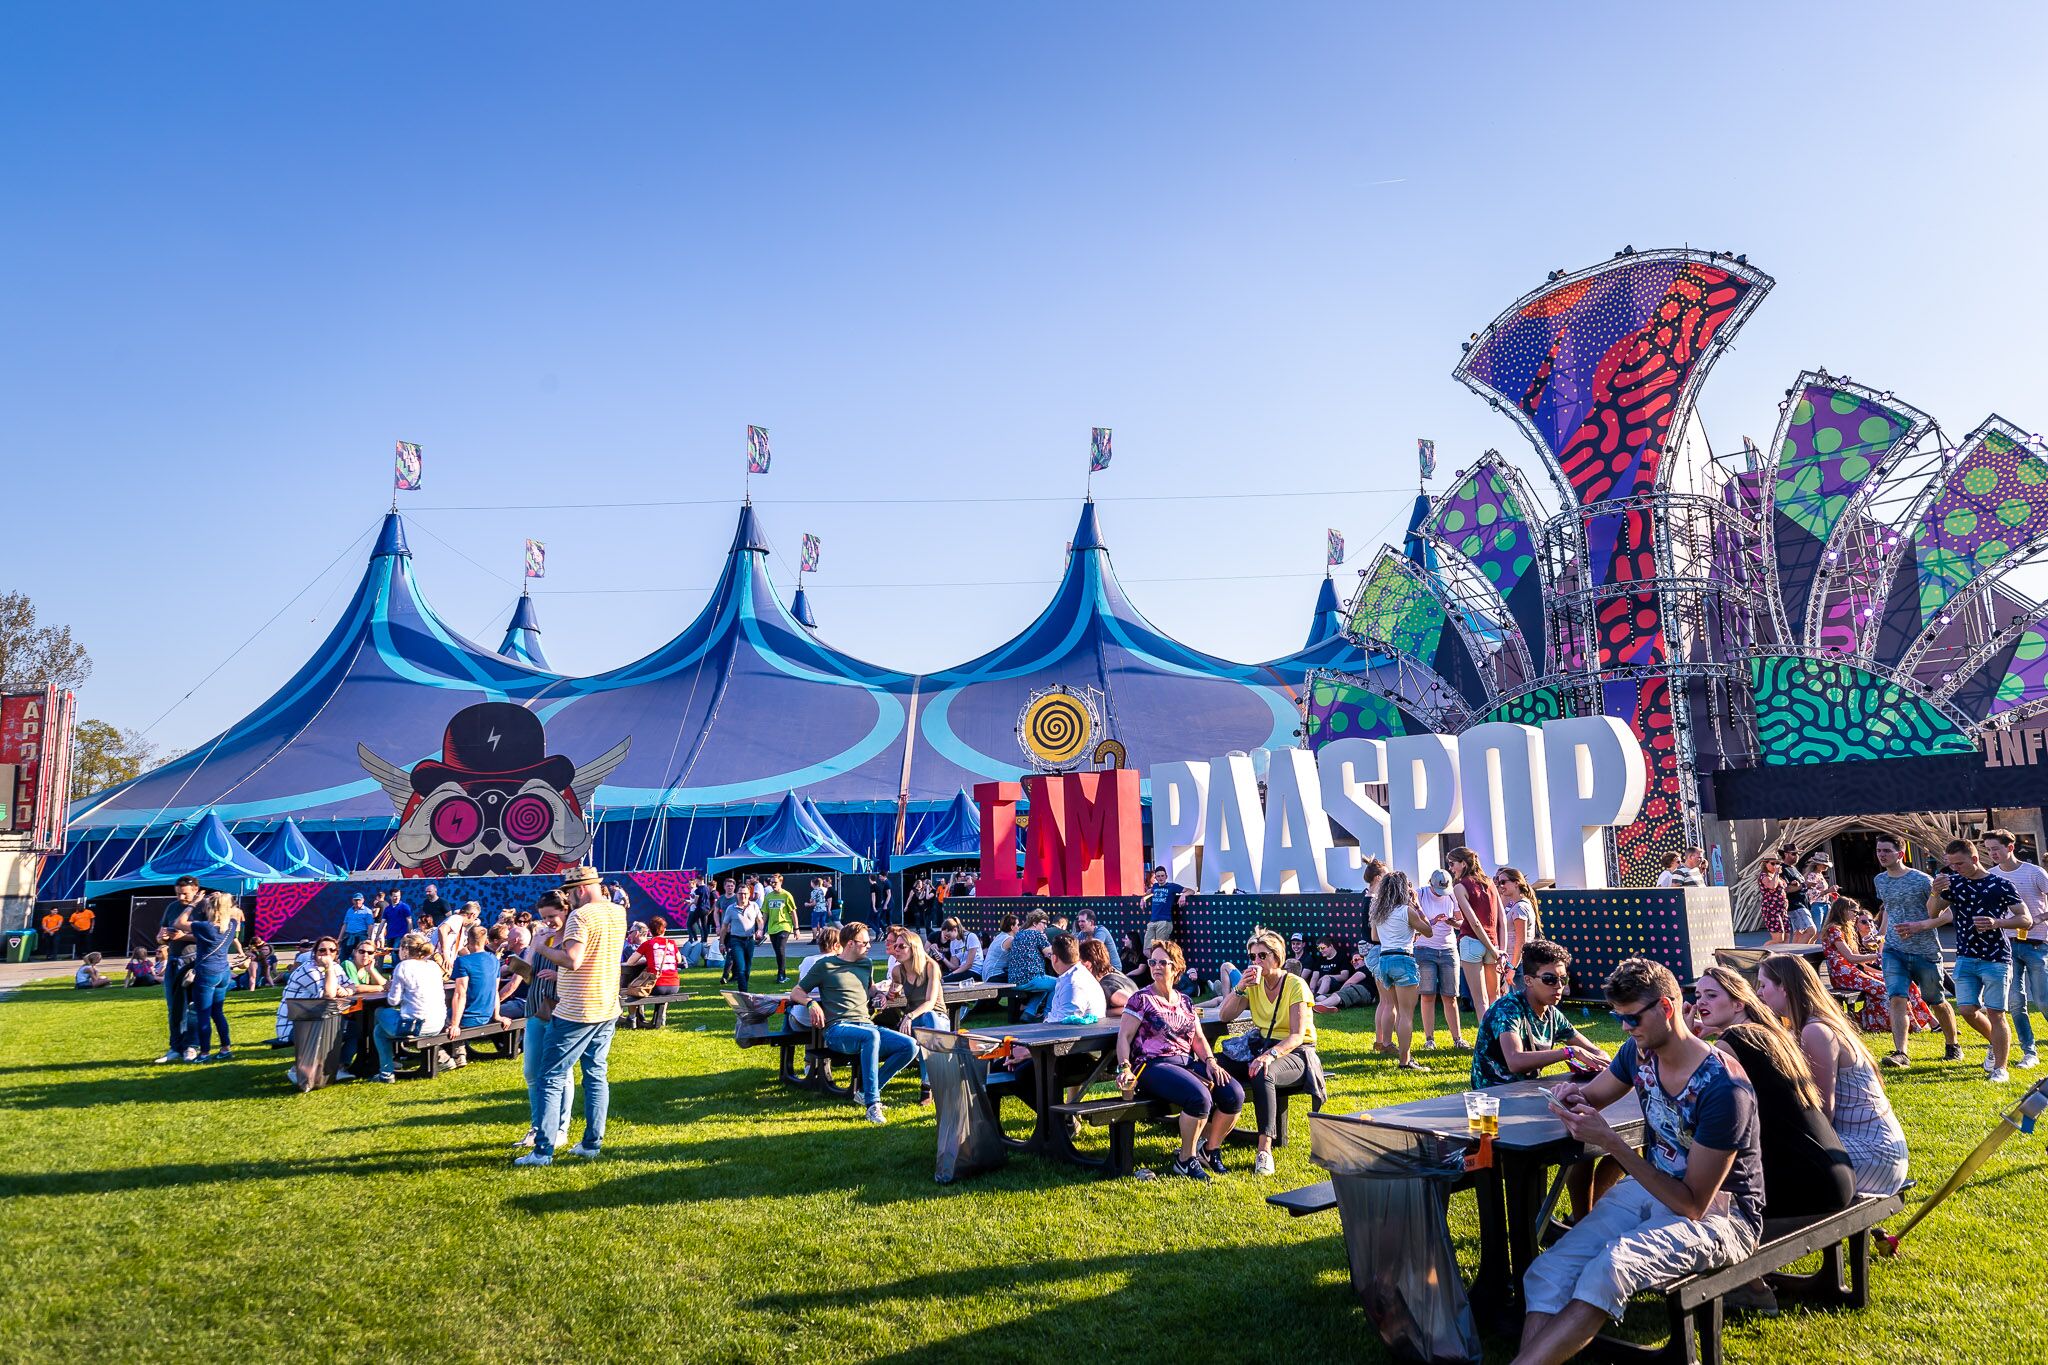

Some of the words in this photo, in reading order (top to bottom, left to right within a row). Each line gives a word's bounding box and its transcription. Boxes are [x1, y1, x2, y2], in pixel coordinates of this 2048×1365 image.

[16, 701, 40, 824] APOLLO
[974, 781, 1022, 896] I
[1022, 769, 1145, 896] AM
[1150, 715, 1647, 895] PAASPOP
[1981, 727, 2048, 768] INF
